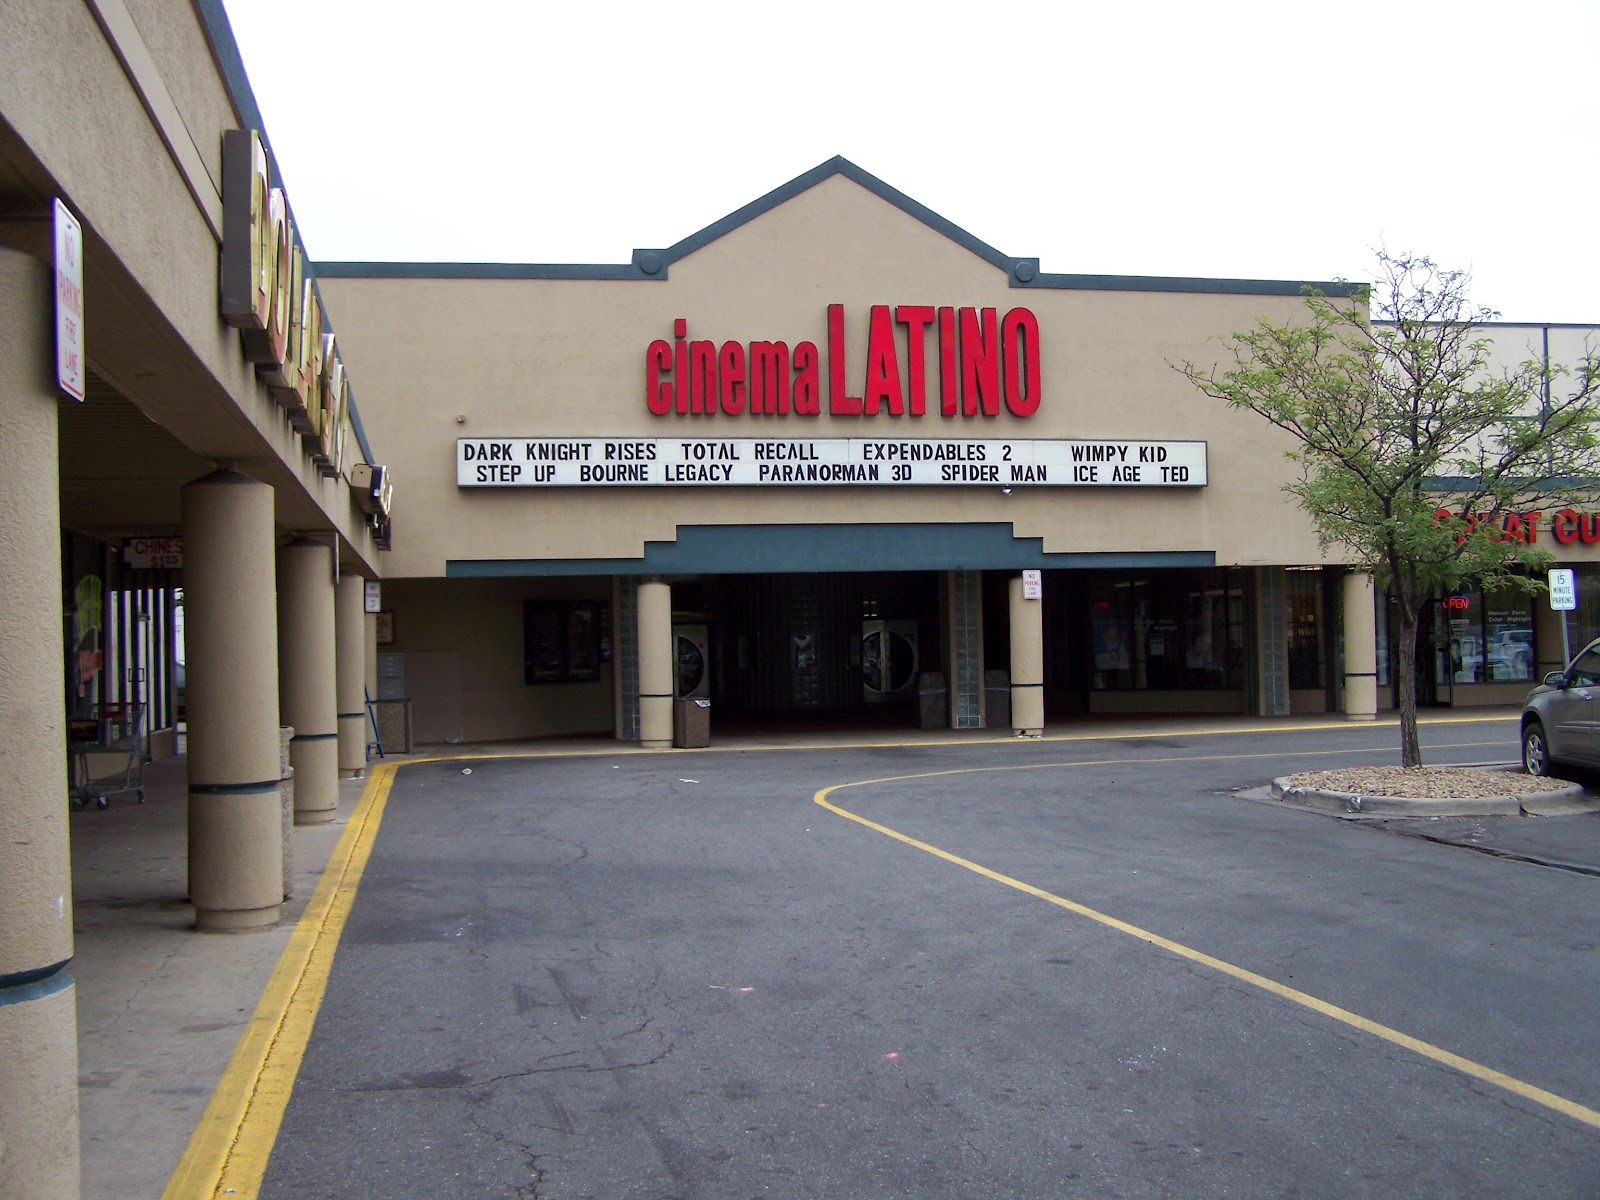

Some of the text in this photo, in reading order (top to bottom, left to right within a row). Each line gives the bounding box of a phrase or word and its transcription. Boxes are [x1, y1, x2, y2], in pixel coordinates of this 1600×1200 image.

[64, 230, 75, 268] NO
[58, 269, 82, 320] PARKING
[65, 316, 77, 345] FIRE
[64, 347, 78, 377] LANE
[646, 303, 1042, 417] cinema LATINO
[464, 443, 1168, 463] DARK KNIGHT RISES TOTAL RECALL EXPENDABLES 2 WIMPY KID
[476, 464, 1190, 483] STEP UP BOURNE LEGACY PARANORMAN 3D SPIDER MAN ICE AGE TED
[1552, 586, 1571, 595] MINUTE
[1556, 574, 1565, 585] 15
[1552, 596, 1573, 605] PARKING
